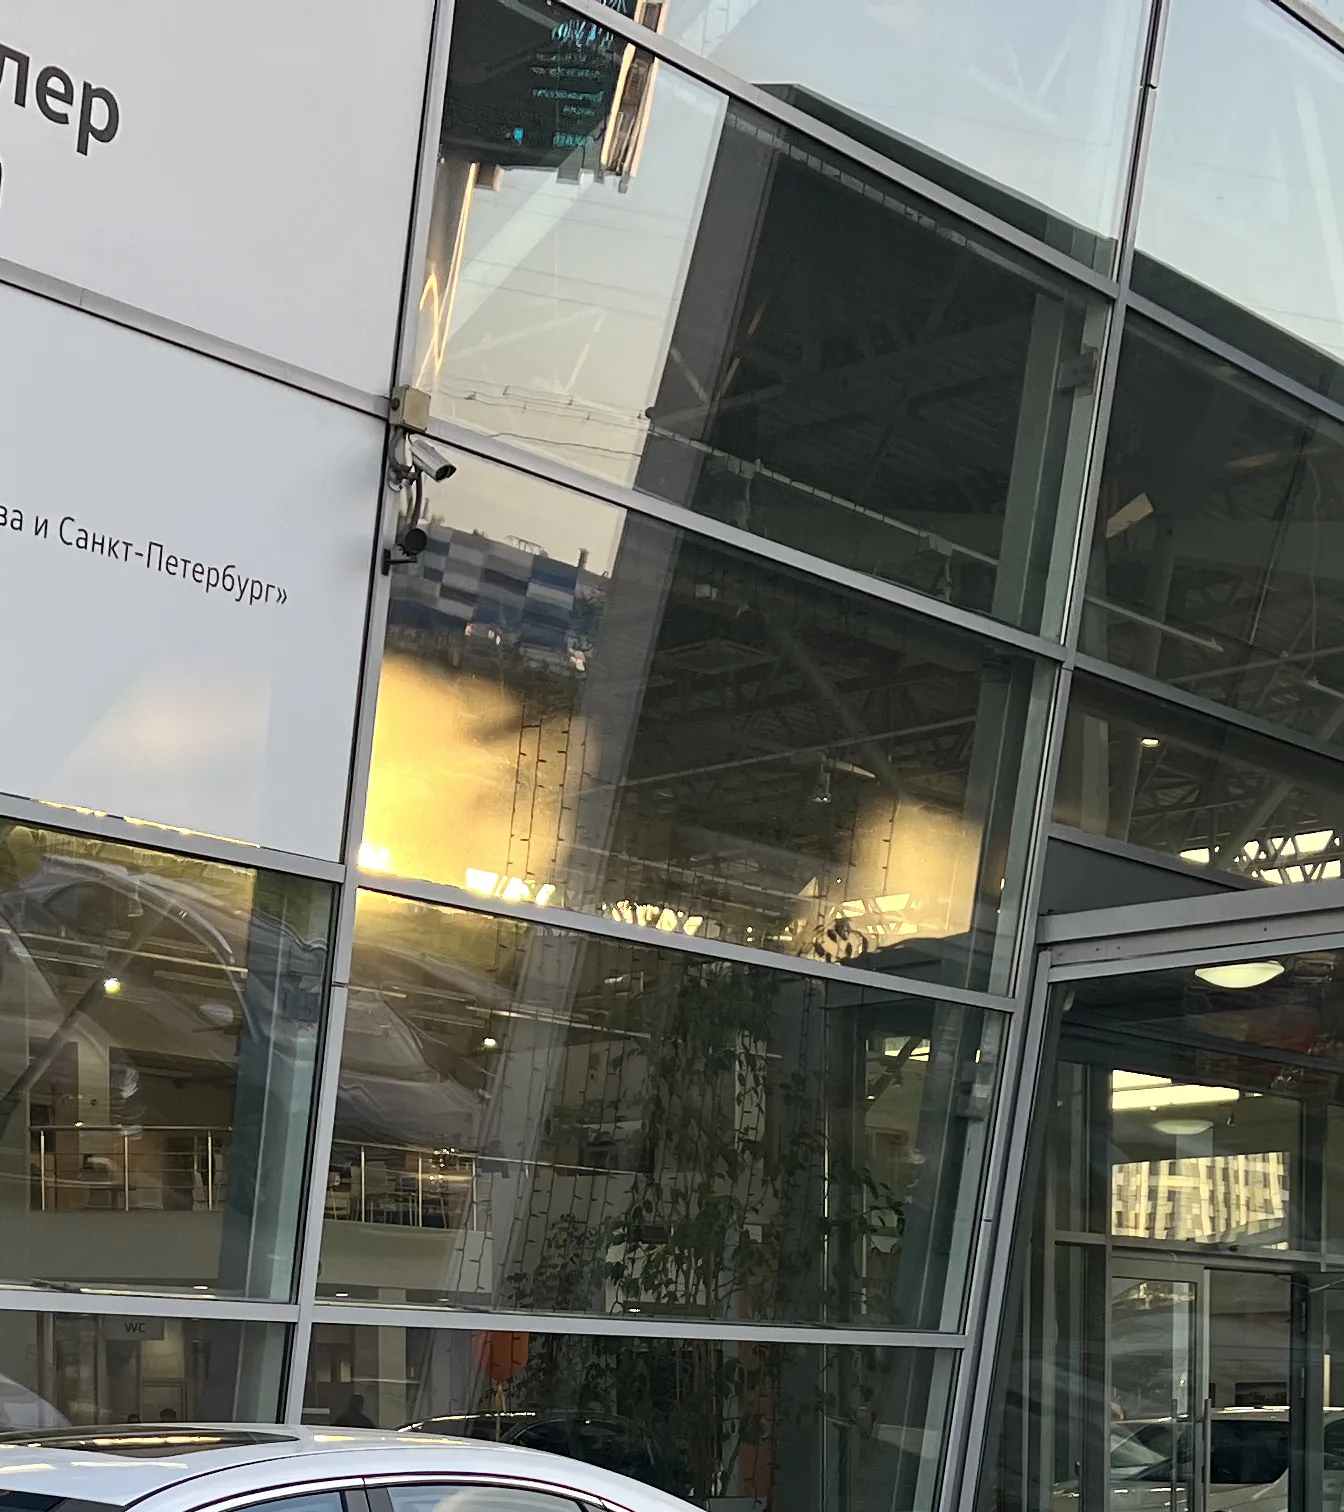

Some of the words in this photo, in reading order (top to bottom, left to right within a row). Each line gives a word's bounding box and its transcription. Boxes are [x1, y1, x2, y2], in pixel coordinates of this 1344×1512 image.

[34, 515, 49, 539] и
[59, 516, 288, 606] Санкт-Петербург»
[123, 1321, 146, 1333] WC
